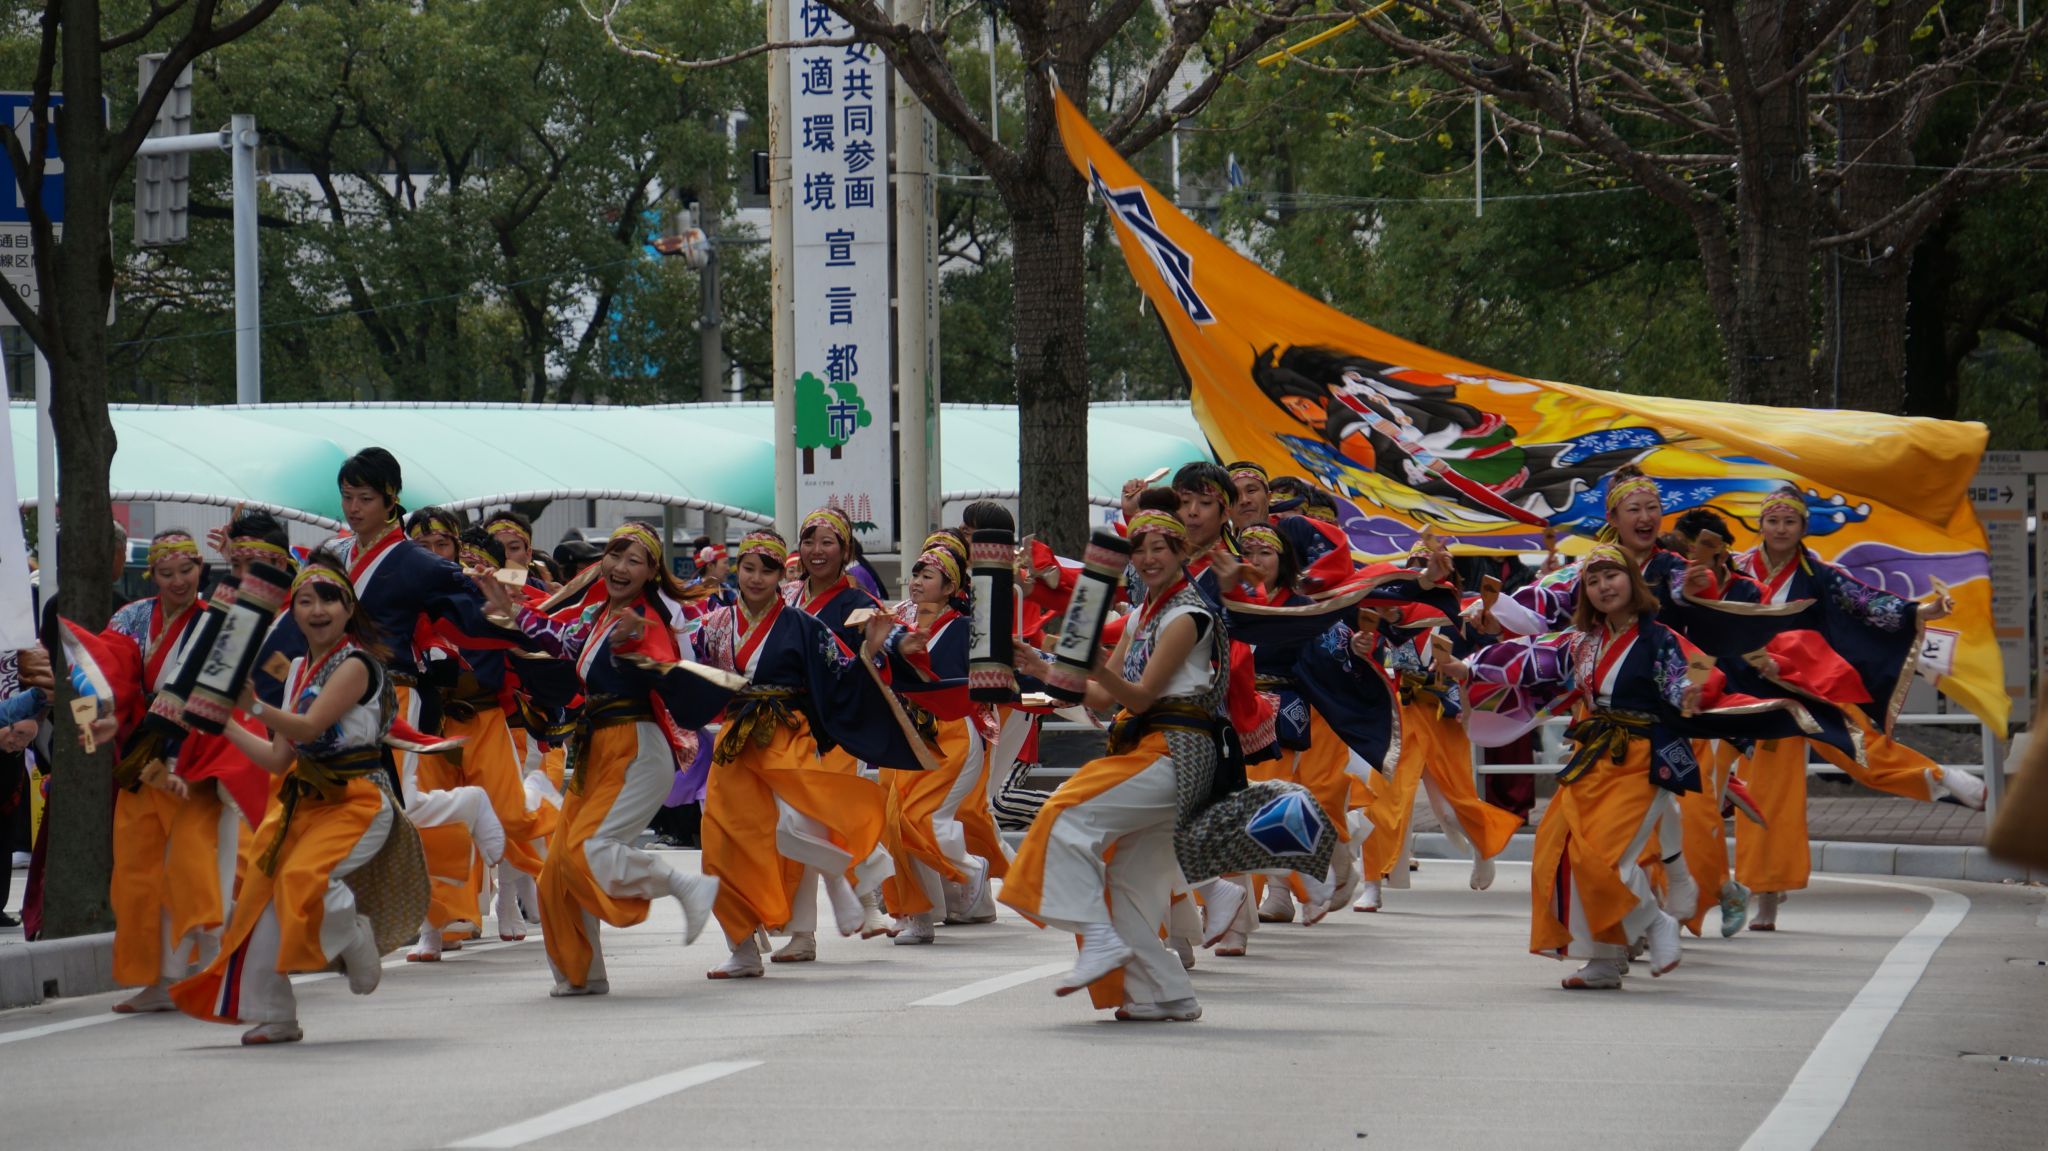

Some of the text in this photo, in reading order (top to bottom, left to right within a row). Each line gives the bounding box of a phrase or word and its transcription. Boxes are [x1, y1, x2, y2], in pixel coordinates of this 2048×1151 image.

[800, 0, 836, 211] 快適環境
[841, 23, 875, 209] 女共同参画
[0, 254, 34, 268] 線区
[825, 227, 858, 441] 宣言都市
